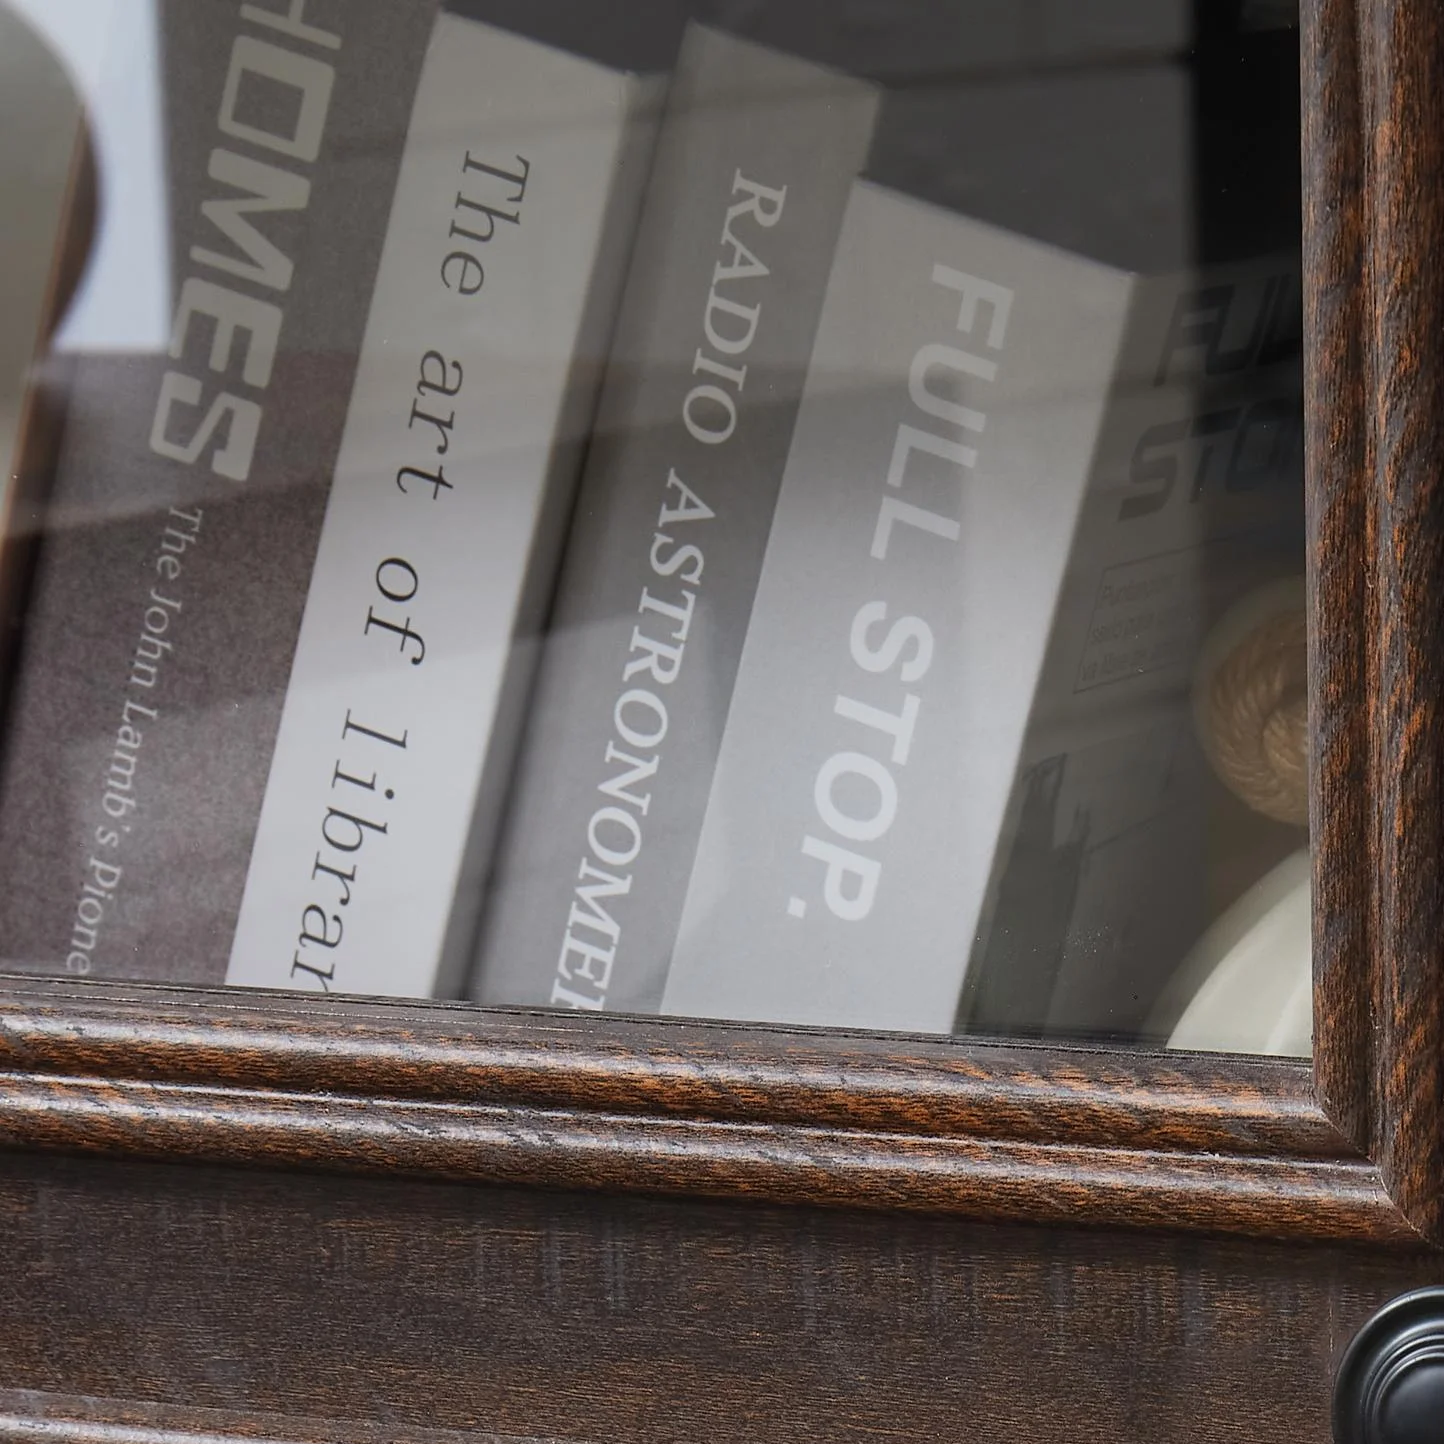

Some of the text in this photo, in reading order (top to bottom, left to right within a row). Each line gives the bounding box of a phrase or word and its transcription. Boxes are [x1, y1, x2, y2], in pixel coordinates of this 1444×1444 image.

[440, 150, 530, 296] The
[682, 168, 788, 445] RADIO
[396, 349, 464, 501] art
[365, 558, 426, 665] of
[787, 263, 1014, 921] FULL STOP.
[65, 507, 204, 976] The John Lamb's Pione
